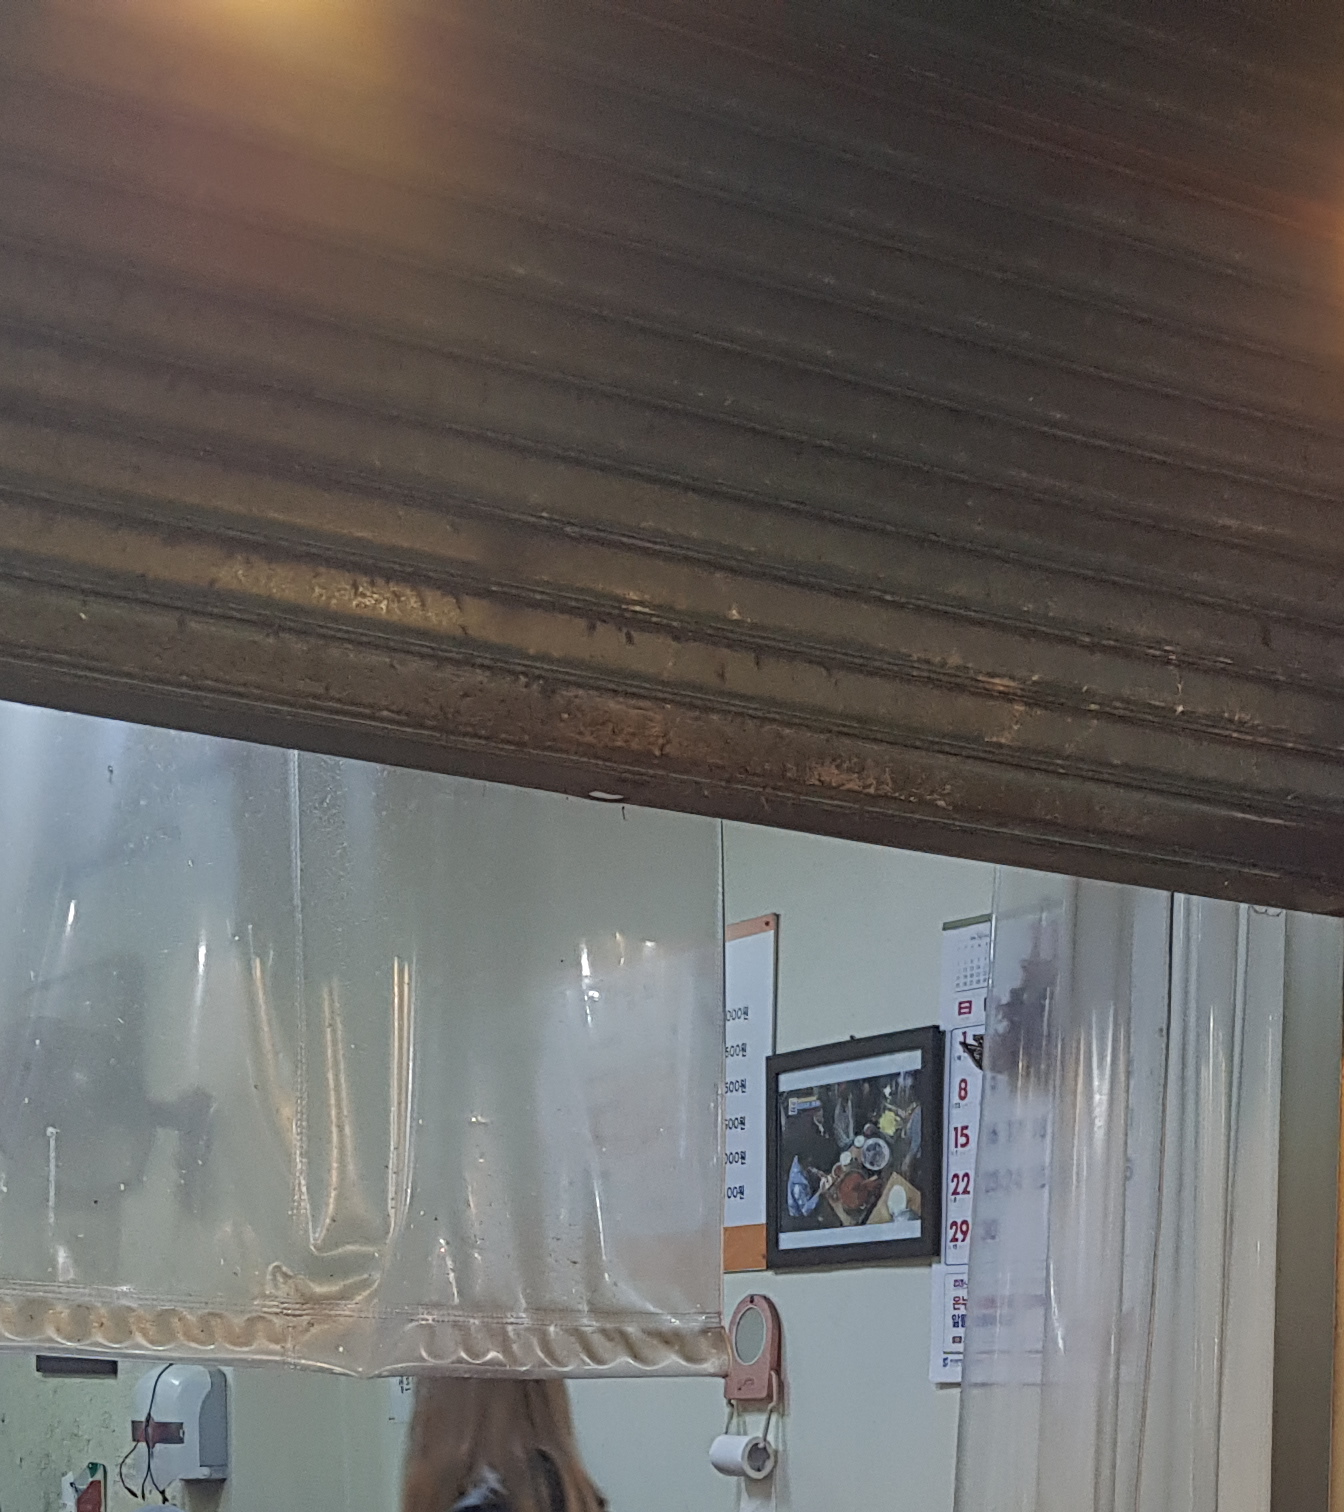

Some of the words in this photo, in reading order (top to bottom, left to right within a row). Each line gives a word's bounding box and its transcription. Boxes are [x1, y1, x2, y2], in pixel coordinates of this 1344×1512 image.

[958, 1077, 969, 1102] 8
[953, 1125, 971, 1149] 15
[950, 1172, 971, 1197] 22
[949, 1219, 970, 1243] 29
